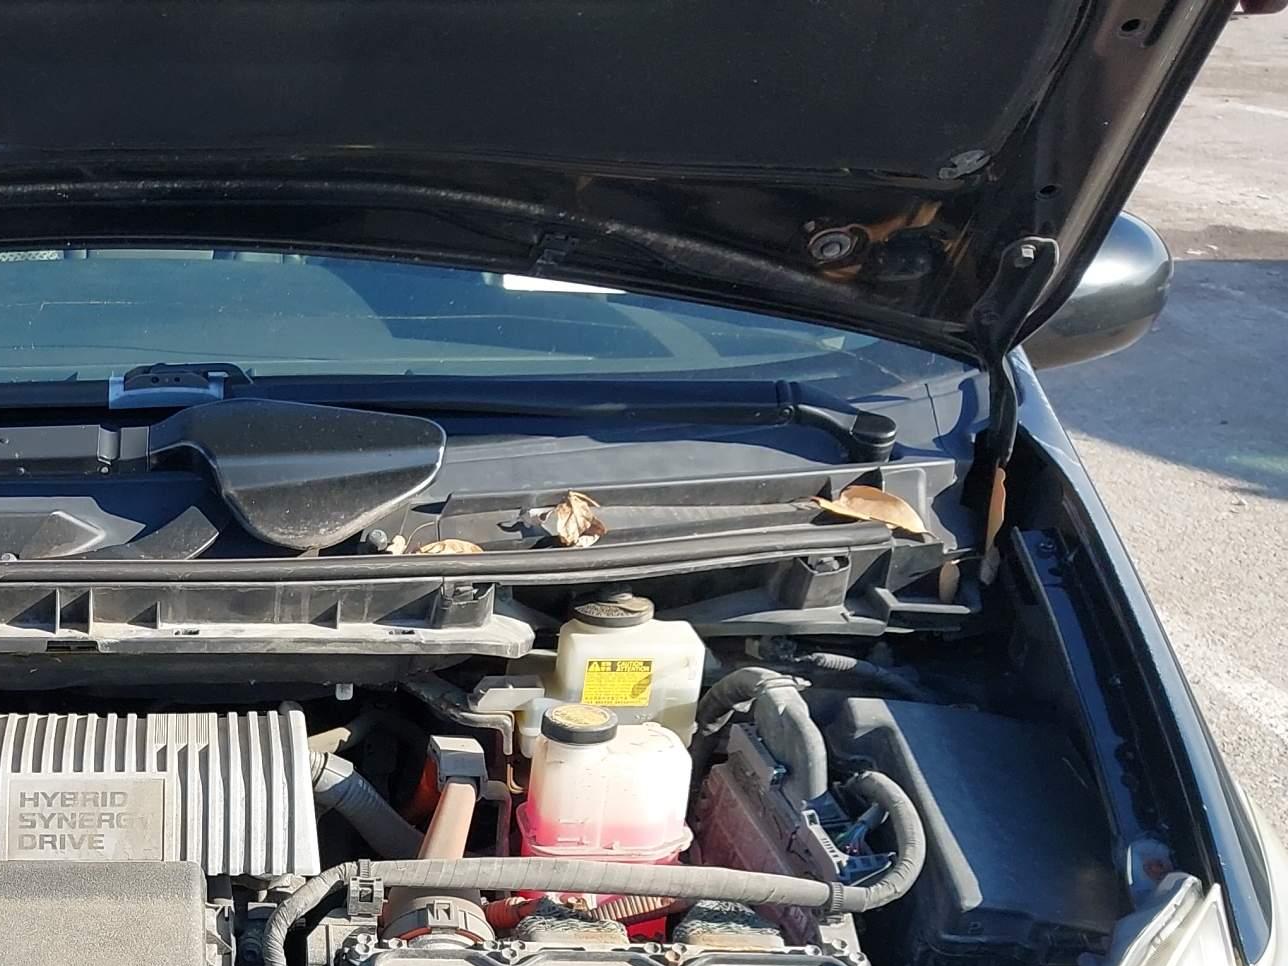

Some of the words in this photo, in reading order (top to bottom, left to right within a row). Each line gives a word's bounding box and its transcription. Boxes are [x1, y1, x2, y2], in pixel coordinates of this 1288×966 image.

[19, 791, 128, 808] HYBRID
[18, 812, 150, 829] SYNERG
[18, 833, 105, 850] DRIVE
